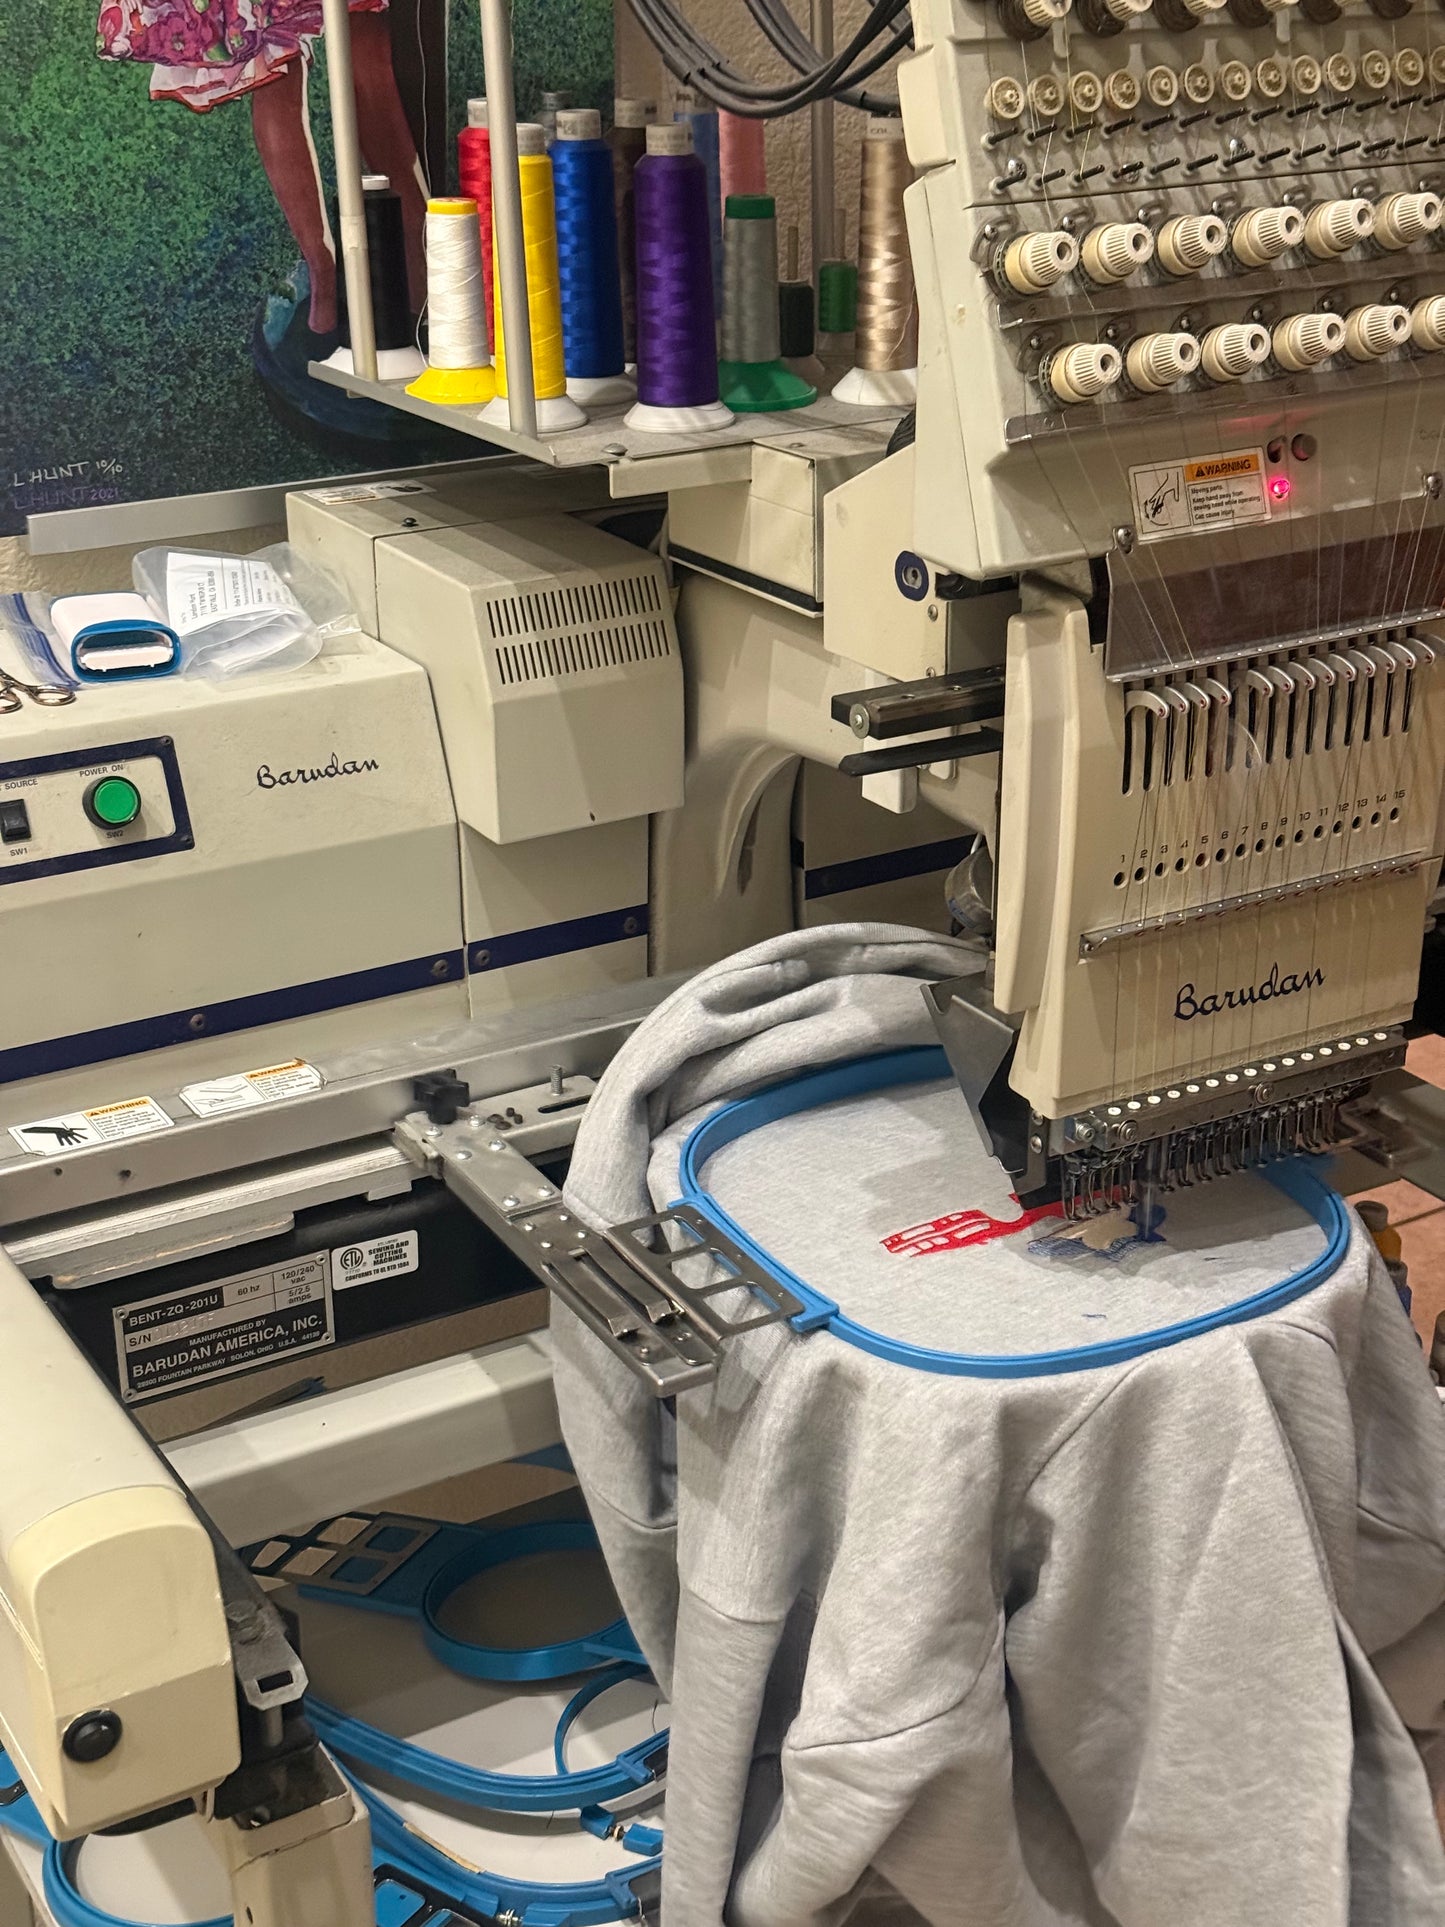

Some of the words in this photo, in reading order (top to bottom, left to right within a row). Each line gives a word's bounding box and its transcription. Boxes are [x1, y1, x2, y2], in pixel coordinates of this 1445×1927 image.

[14, 473, 25, 487] L
[29, 461, 90, 483] HUNT
[95, 458, 123, 476] 10/10
[1205, 459, 1251, 475] WARNING
[91, 487, 119, 500] 2021
[79, 766, 108, 777] POWER
[111, 764, 124, 772] ON
[257, 752, 379, 789] Barudan
[4, 778, 39, 790] SOURCE
[1120, 854, 1126, 863] 1
[1140, 849, 1148, 858] 2
[1160, 844, 1169, 854] 3
[1180, 840, 1189, 849] 4
[1201, 835, 1209, 844] 5
[1221, 830, 1229, 840] 6
[1241, 826, 1249, 835] 7
[1261, 821, 1269, 830] 8
[1280, 816, 1288, 825] 9
[1300, 812, 1311, 821] 10
[1319, 807, 1329, 817] 11
[1338, 803, 1349, 812] 12
[1357, 798, 1368, 808] 13
[1375, 794, 1387, 804] 14
[1394, 789, 1406, 799] 15
[106, 830, 124, 839] SW2
[10, 848, 28, 857] SW1
[1173, 962, 1325, 1020] Barudan
[99, 1100, 147, 1114] WARNING
[368, 1244, 394, 1255] SEWING
[396, 1240, 409, 1248] AND
[374, 1248, 403, 1259] CUTTING
[373, 1253, 407, 1266] MACHINES
[281, 1265, 315, 1280] 120/240
[345, 1270, 372, 1281] CONFORMS
[290, 1276, 306, 1284] vac
[237, 1287, 248, 1296] 60
[250, 1284, 260, 1293] hz
[288, 1286, 311, 1297] 5/2.5
[288, 1293, 312, 1304] amps
[189, 1322, 254, 1346] MANUFACTURED
[255, 1319, 266, 1327] BY
[129, 1333, 151, 1347] S/N
[133, 1345, 211, 1378] BARUDAN
[214, 1325, 289, 1354] AMERICA,
[293, 1315, 322, 1332] INC.
[158, 1367, 192, 1383] FOUNTAIN
[193, 1358, 226, 1373] PARKWAY
